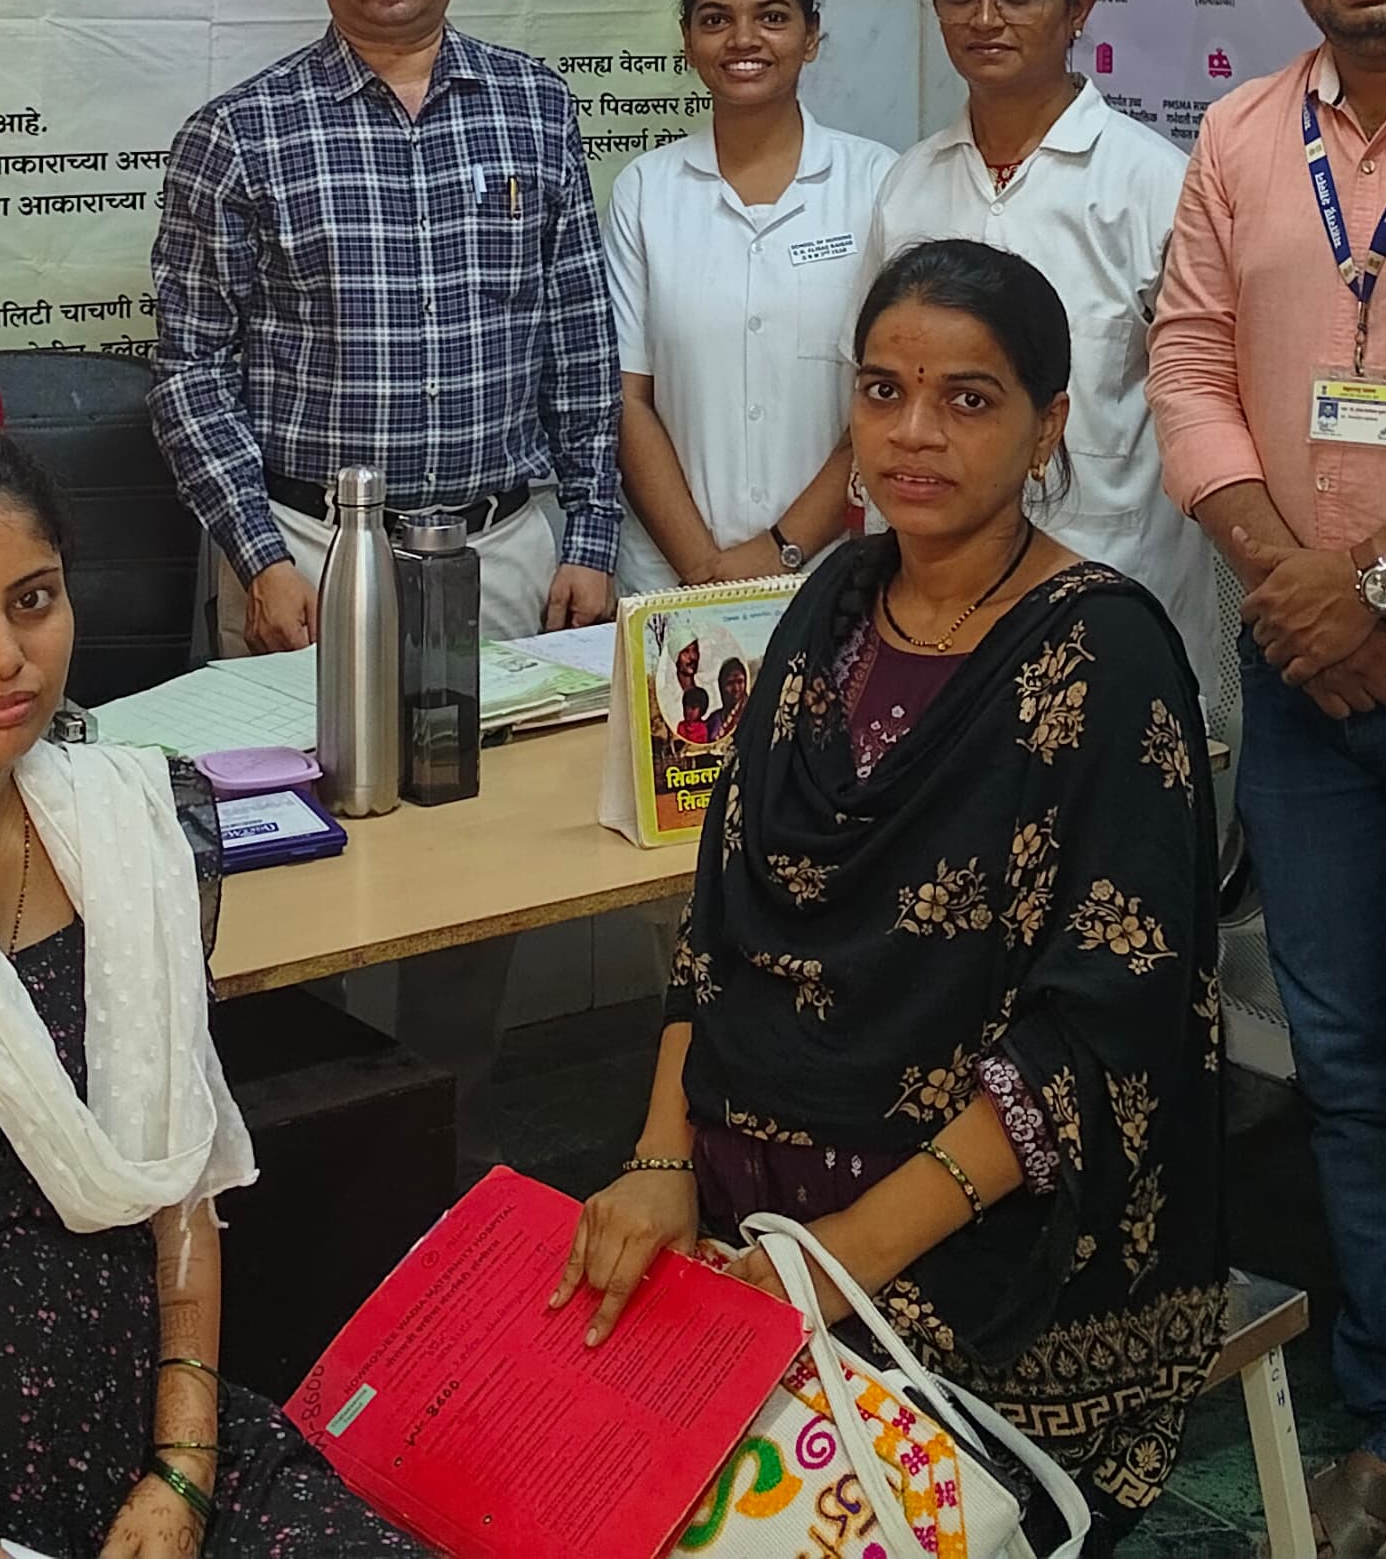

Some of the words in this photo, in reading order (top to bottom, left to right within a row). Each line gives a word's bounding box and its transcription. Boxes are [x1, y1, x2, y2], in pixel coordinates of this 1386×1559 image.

[558, 56, 613, 77] असह्य
[619, 49, 667, 75] वेदना
[600, 92, 680, 117] पिवळसर
[18, 192, 148, 218] आकाराच्या
[60, 294, 133, 325] चाचणी
[474, 1204, 517, 1252] HOSPITAL
